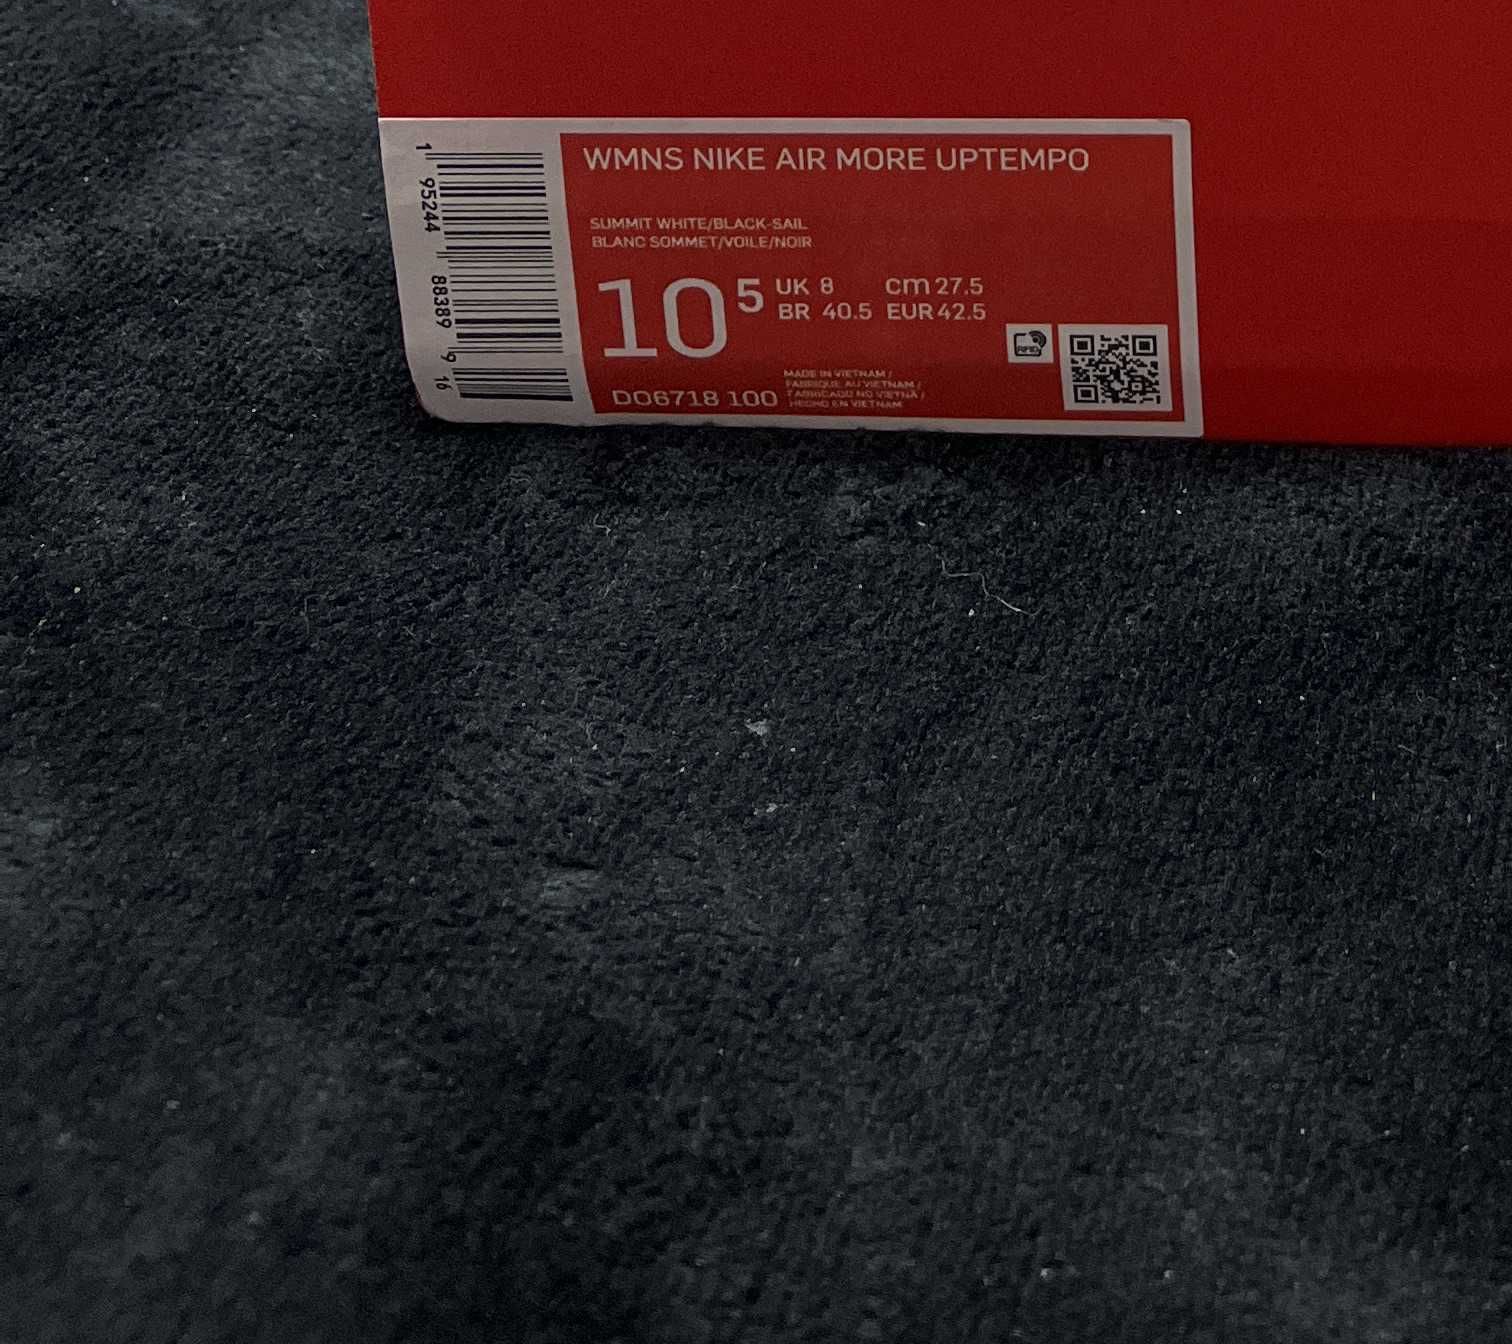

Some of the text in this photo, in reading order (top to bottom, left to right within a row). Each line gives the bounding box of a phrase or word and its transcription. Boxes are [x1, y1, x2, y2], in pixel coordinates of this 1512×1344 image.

[583, 147, 1089, 171] WMNS NIKE AIR MORE UPTEMPO
[590, 217, 808, 231] SUMMIT WHITE/BLACK-SAIL
[592, 235, 813, 249] BLANC SOMMET/VOILE/NOIR
[416, 143, 457, 362] 1 95244 88389 9
[775, 277, 983, 295] UK 8 cm 27.5
[598, 277, 727, 359] 10
[779, 303, 987, 321] BR 40.5 EUR 42.5
[728, 390, 778, 407] 100
